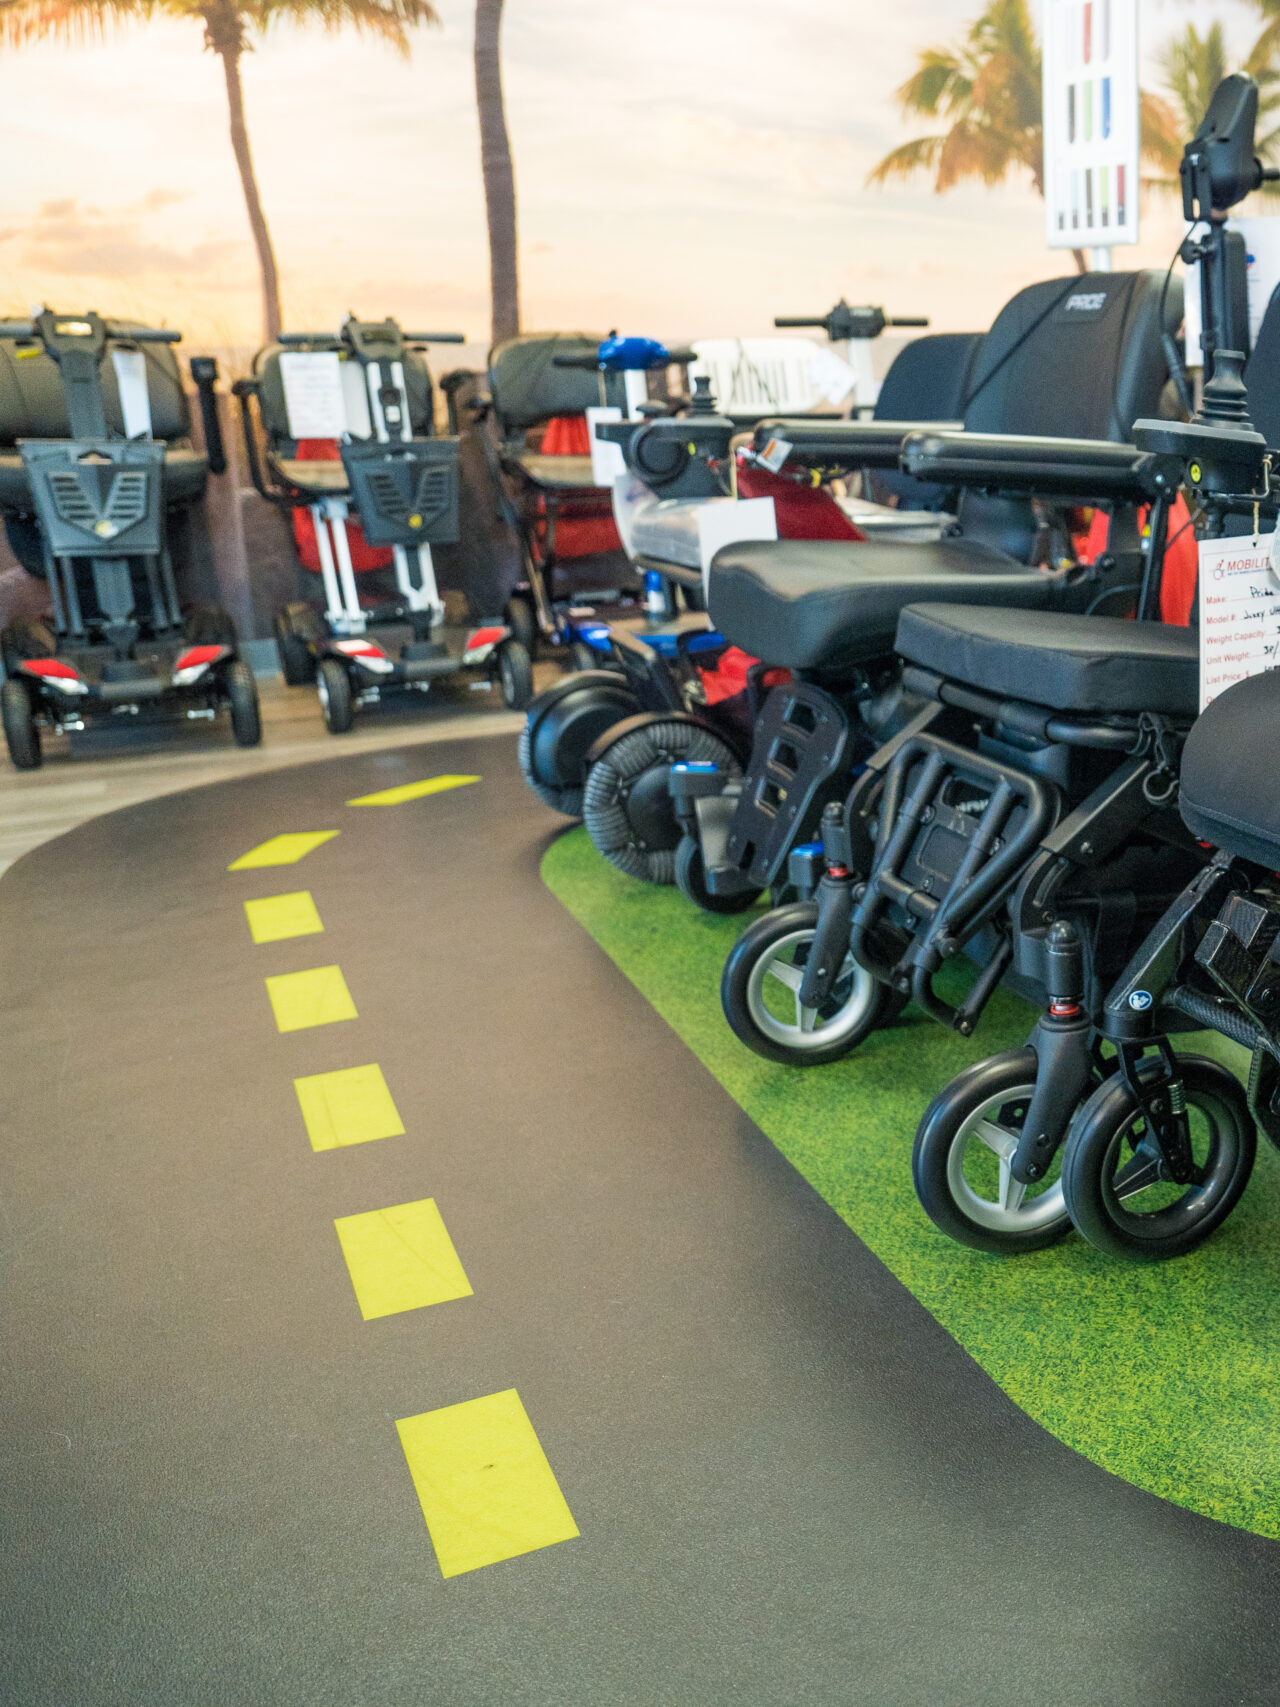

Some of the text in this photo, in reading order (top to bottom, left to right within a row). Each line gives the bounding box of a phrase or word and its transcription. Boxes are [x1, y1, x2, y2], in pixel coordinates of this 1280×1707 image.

[1227, 556, 1269, 571] MOBILIT
[1206, 615, 1229, 625] Model
[1206, 634, 1233, 645] Weight
[1206, 656, 1222, 665] Unit
[1206, 676, 1221, 685] List
